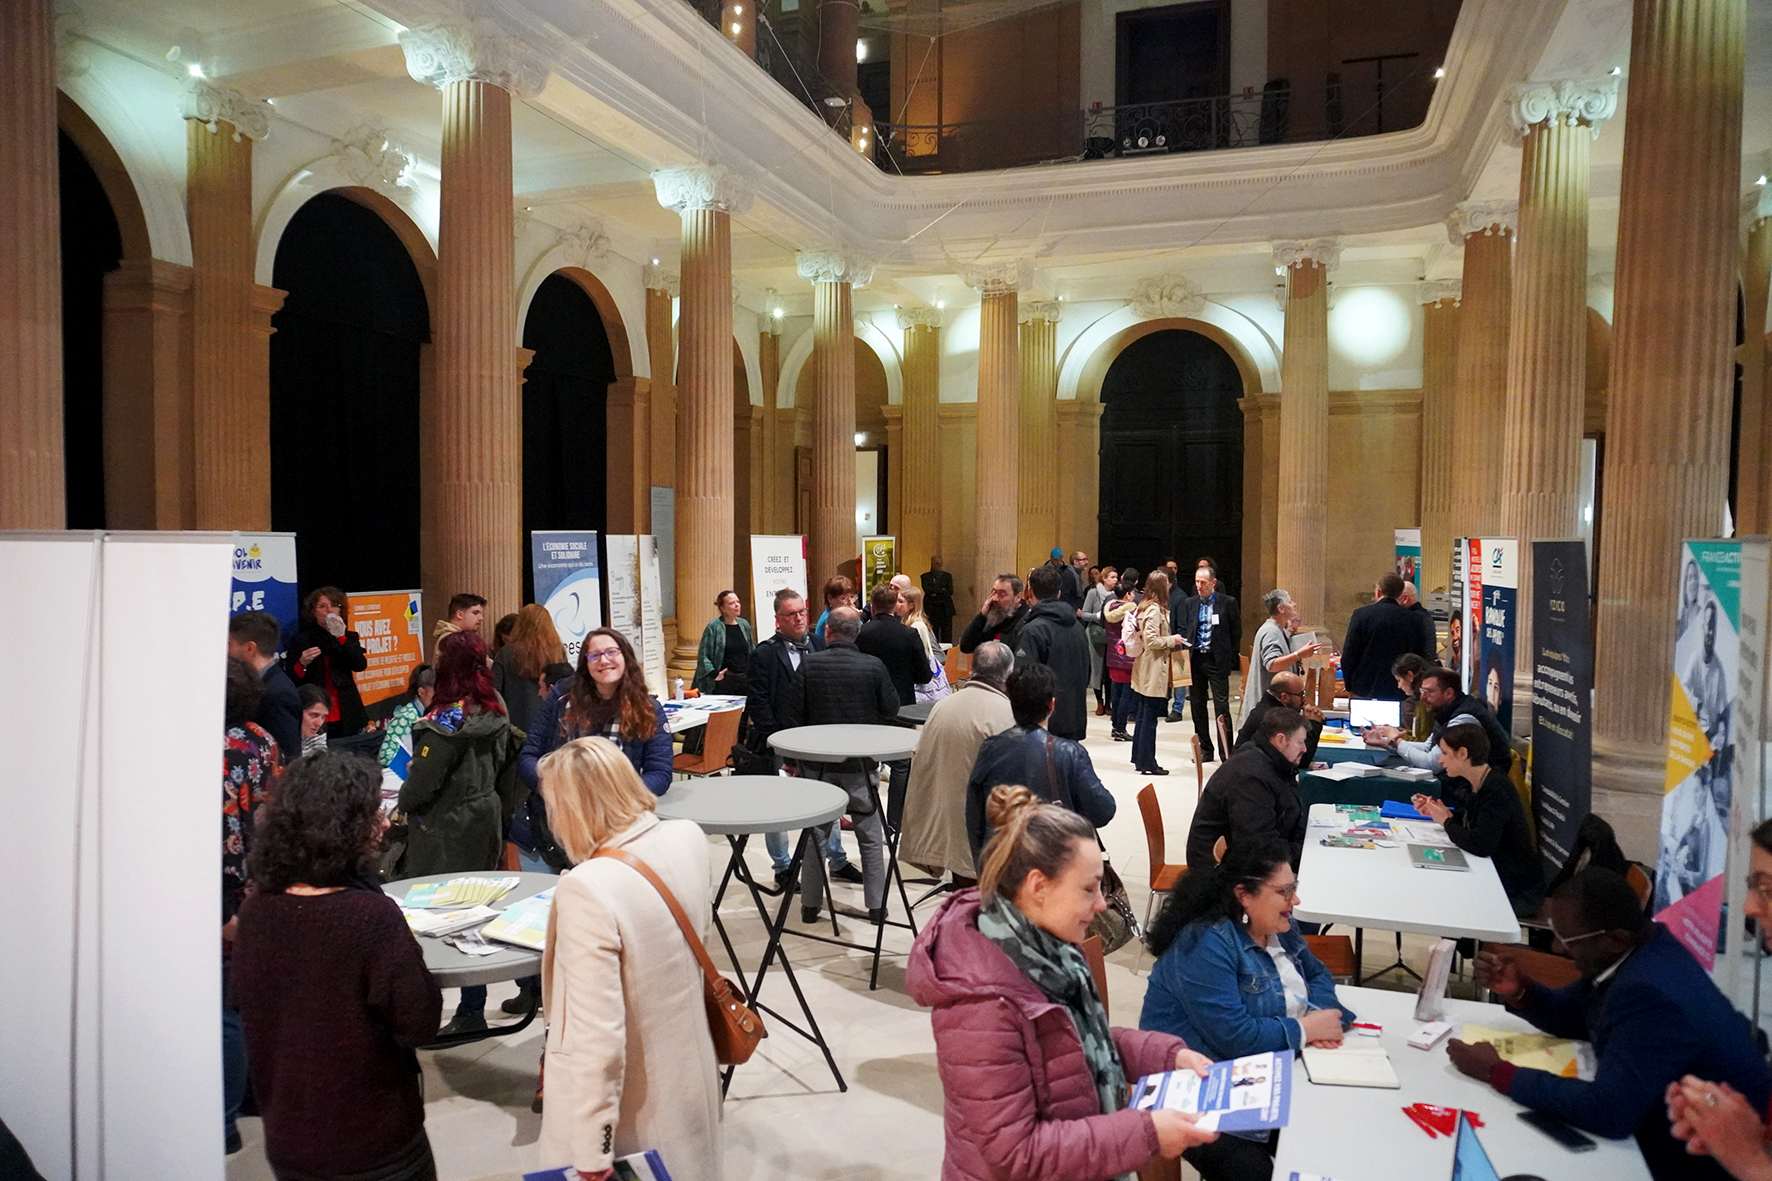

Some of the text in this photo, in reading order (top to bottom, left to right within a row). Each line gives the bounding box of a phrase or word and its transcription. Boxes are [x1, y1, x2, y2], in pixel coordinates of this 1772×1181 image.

[570, 542, 587, 550] SOCIALE
[551, 551, 580, 560] ET SOLIDAIRE
[355, 620, 374, 638] VOUS
[374, 619, 391, 635] AVEZ
[366, 636, 392, 654] PROJET
[393, 635, 398, 652] ?
